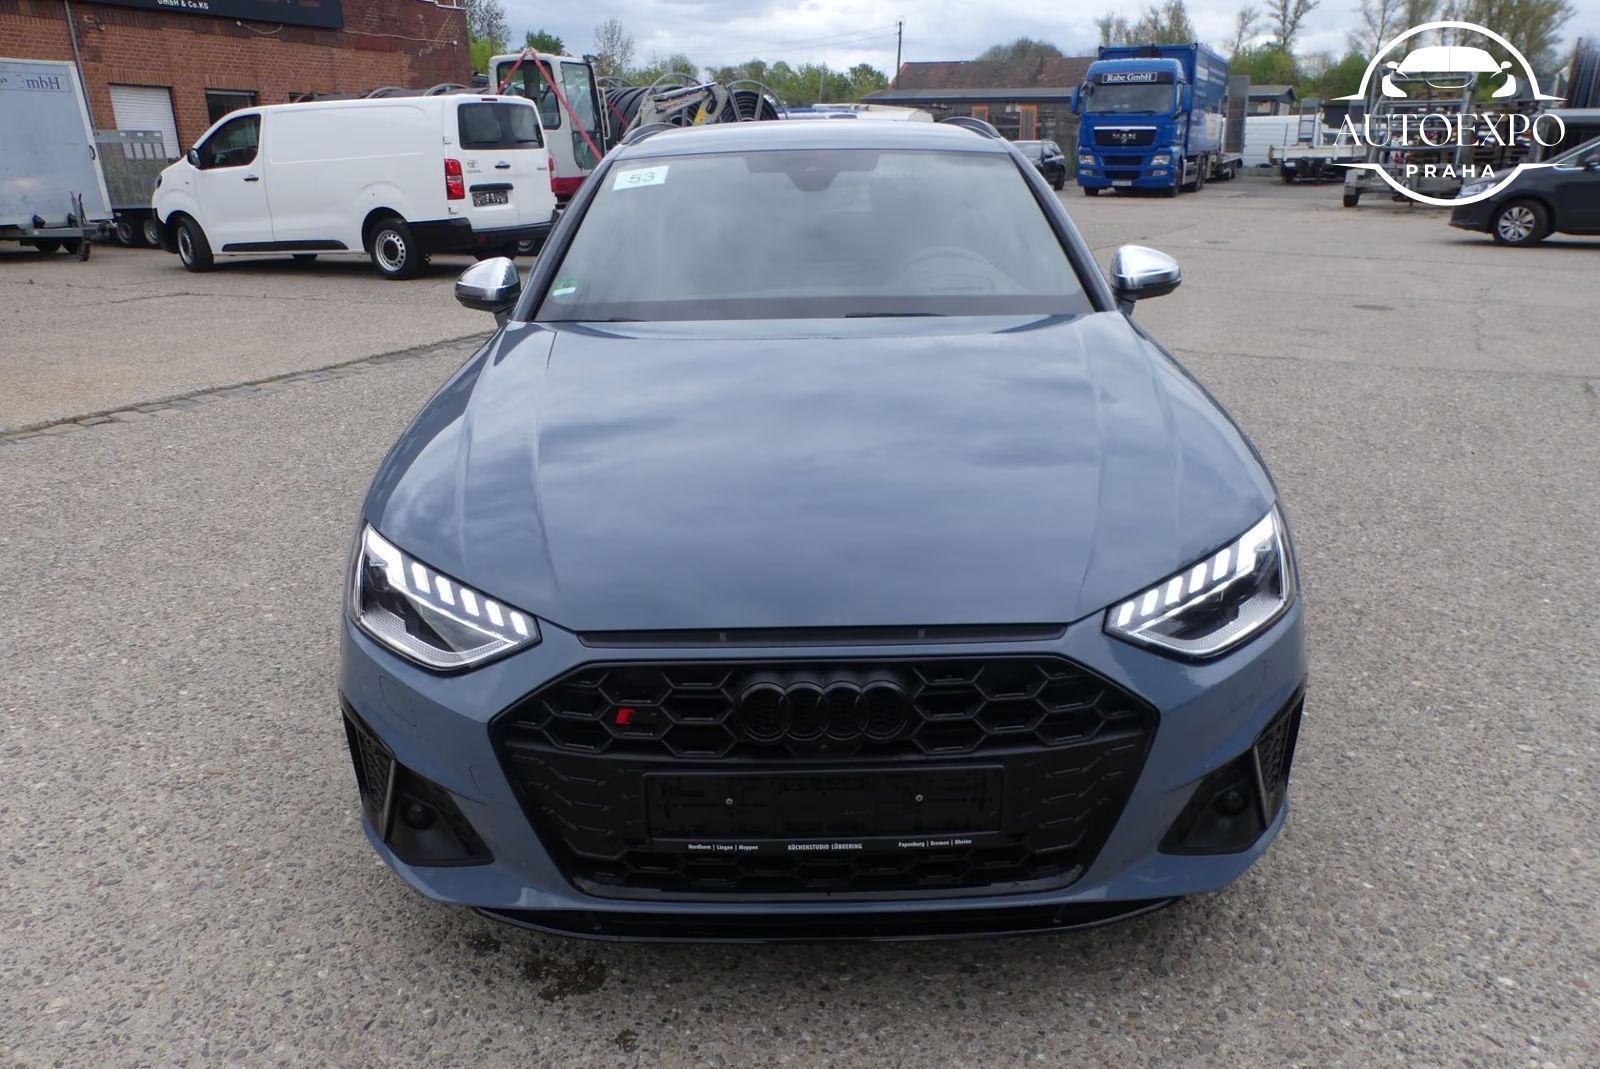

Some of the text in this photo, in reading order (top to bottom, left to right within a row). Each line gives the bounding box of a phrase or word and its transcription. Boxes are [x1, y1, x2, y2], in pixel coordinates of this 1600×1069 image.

[16, 75, 61, 90] mbH
[1127, 72, 1152, 81] GmbH
[628, 171, 655, 184] 53
